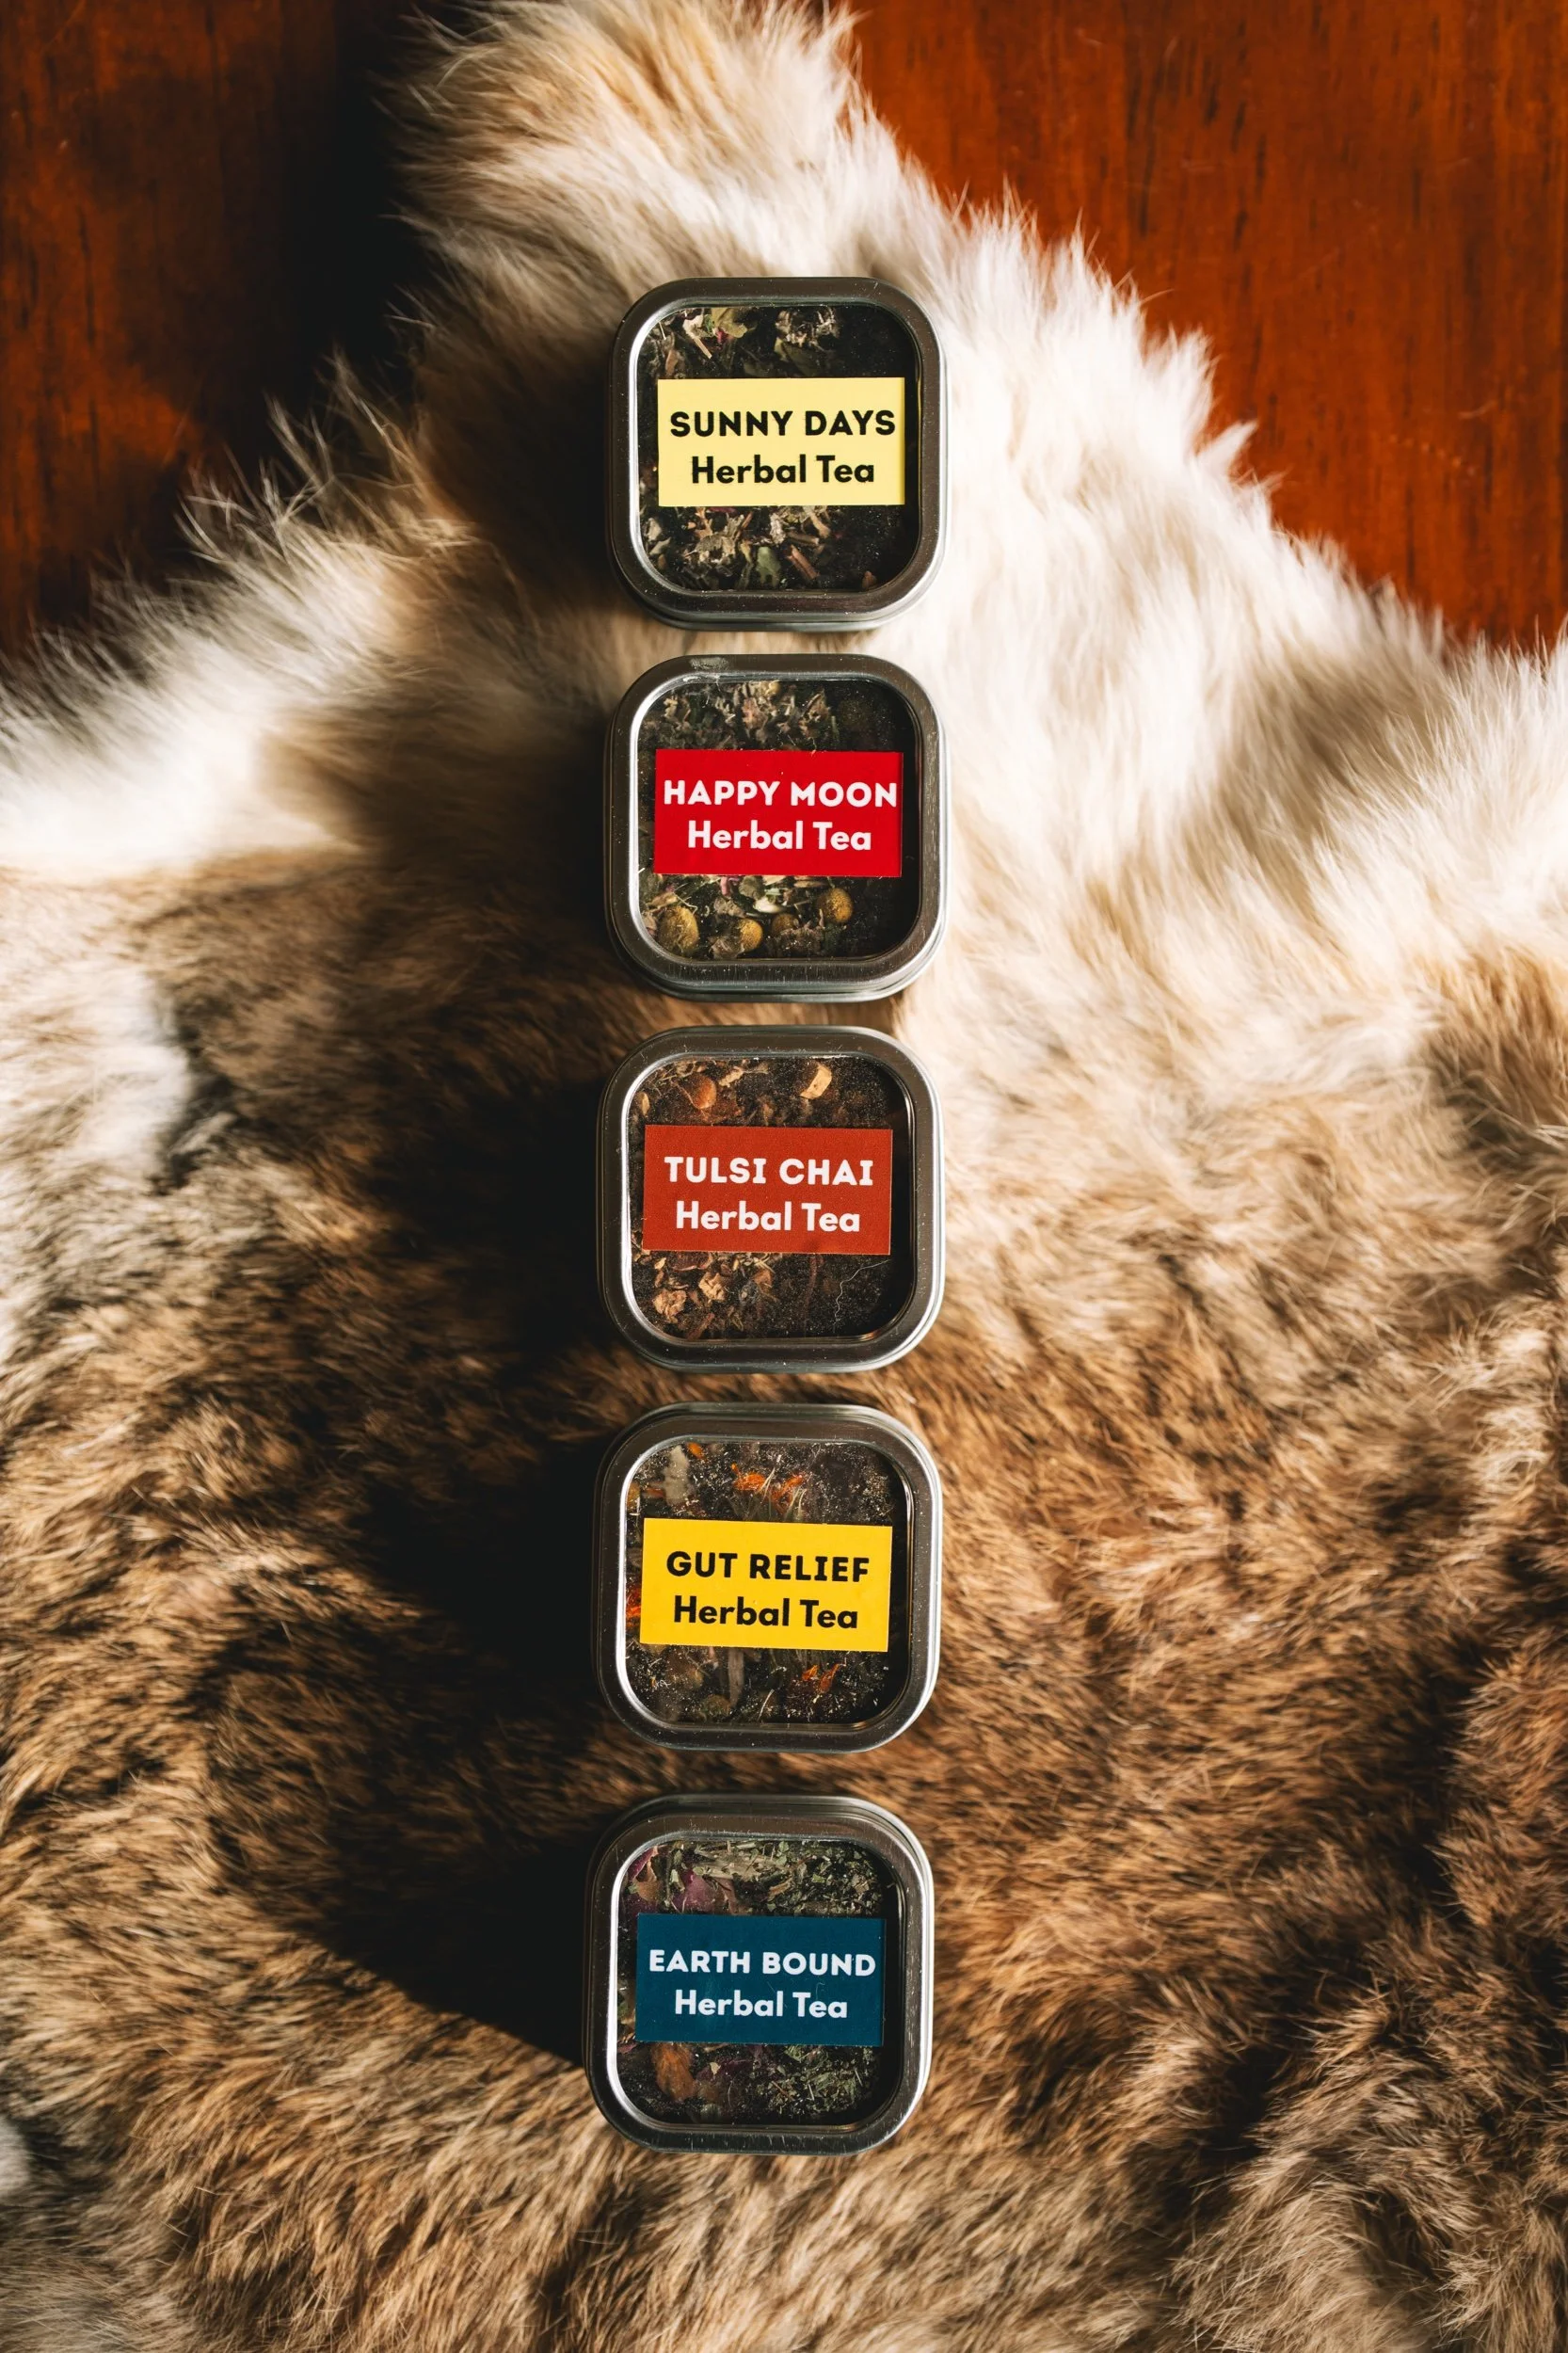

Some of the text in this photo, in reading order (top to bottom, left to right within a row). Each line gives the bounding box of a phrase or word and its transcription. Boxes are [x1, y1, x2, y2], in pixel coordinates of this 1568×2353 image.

[670, 409, 896, 438] SUNNY DAYS
[692, 454, 874, 485] Herbal Tea
[664, 779, 897, 808] HAPPY MOON
[688, 819, 872, 851] Herbal Tea
[664, 1156, 873, 1186] TULSI CHAI
[676, 1200, 860, 1233] Herbal Tea
[666, 1550, 870, 1583] GUT RELIEF
[674, 1594, 858, 1629] Herbal Tea
[649, 1949, 876, 1977] EARTH BOUND
[675, 1989, 848, 2019] Herbal Tea
